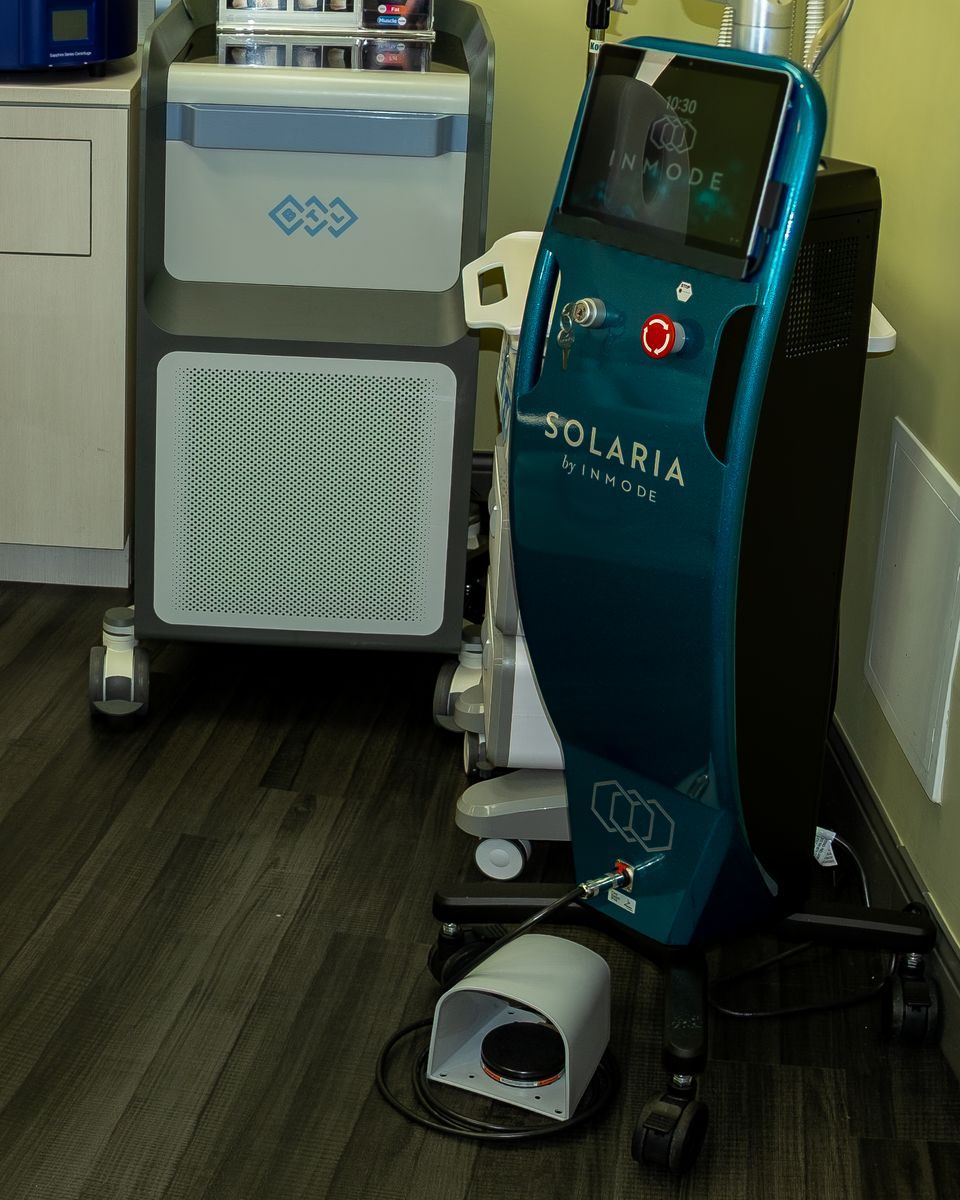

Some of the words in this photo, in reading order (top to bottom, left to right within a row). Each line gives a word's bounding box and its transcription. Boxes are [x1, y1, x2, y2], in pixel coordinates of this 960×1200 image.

[666, 95, 697, 114] 10:30
[608, 149, 724, 191] INMODE
[544, 411, 685, 487] SOLARIA
[562, 454, 577, 475] by
[581, 464, 657, 503] INMODE
